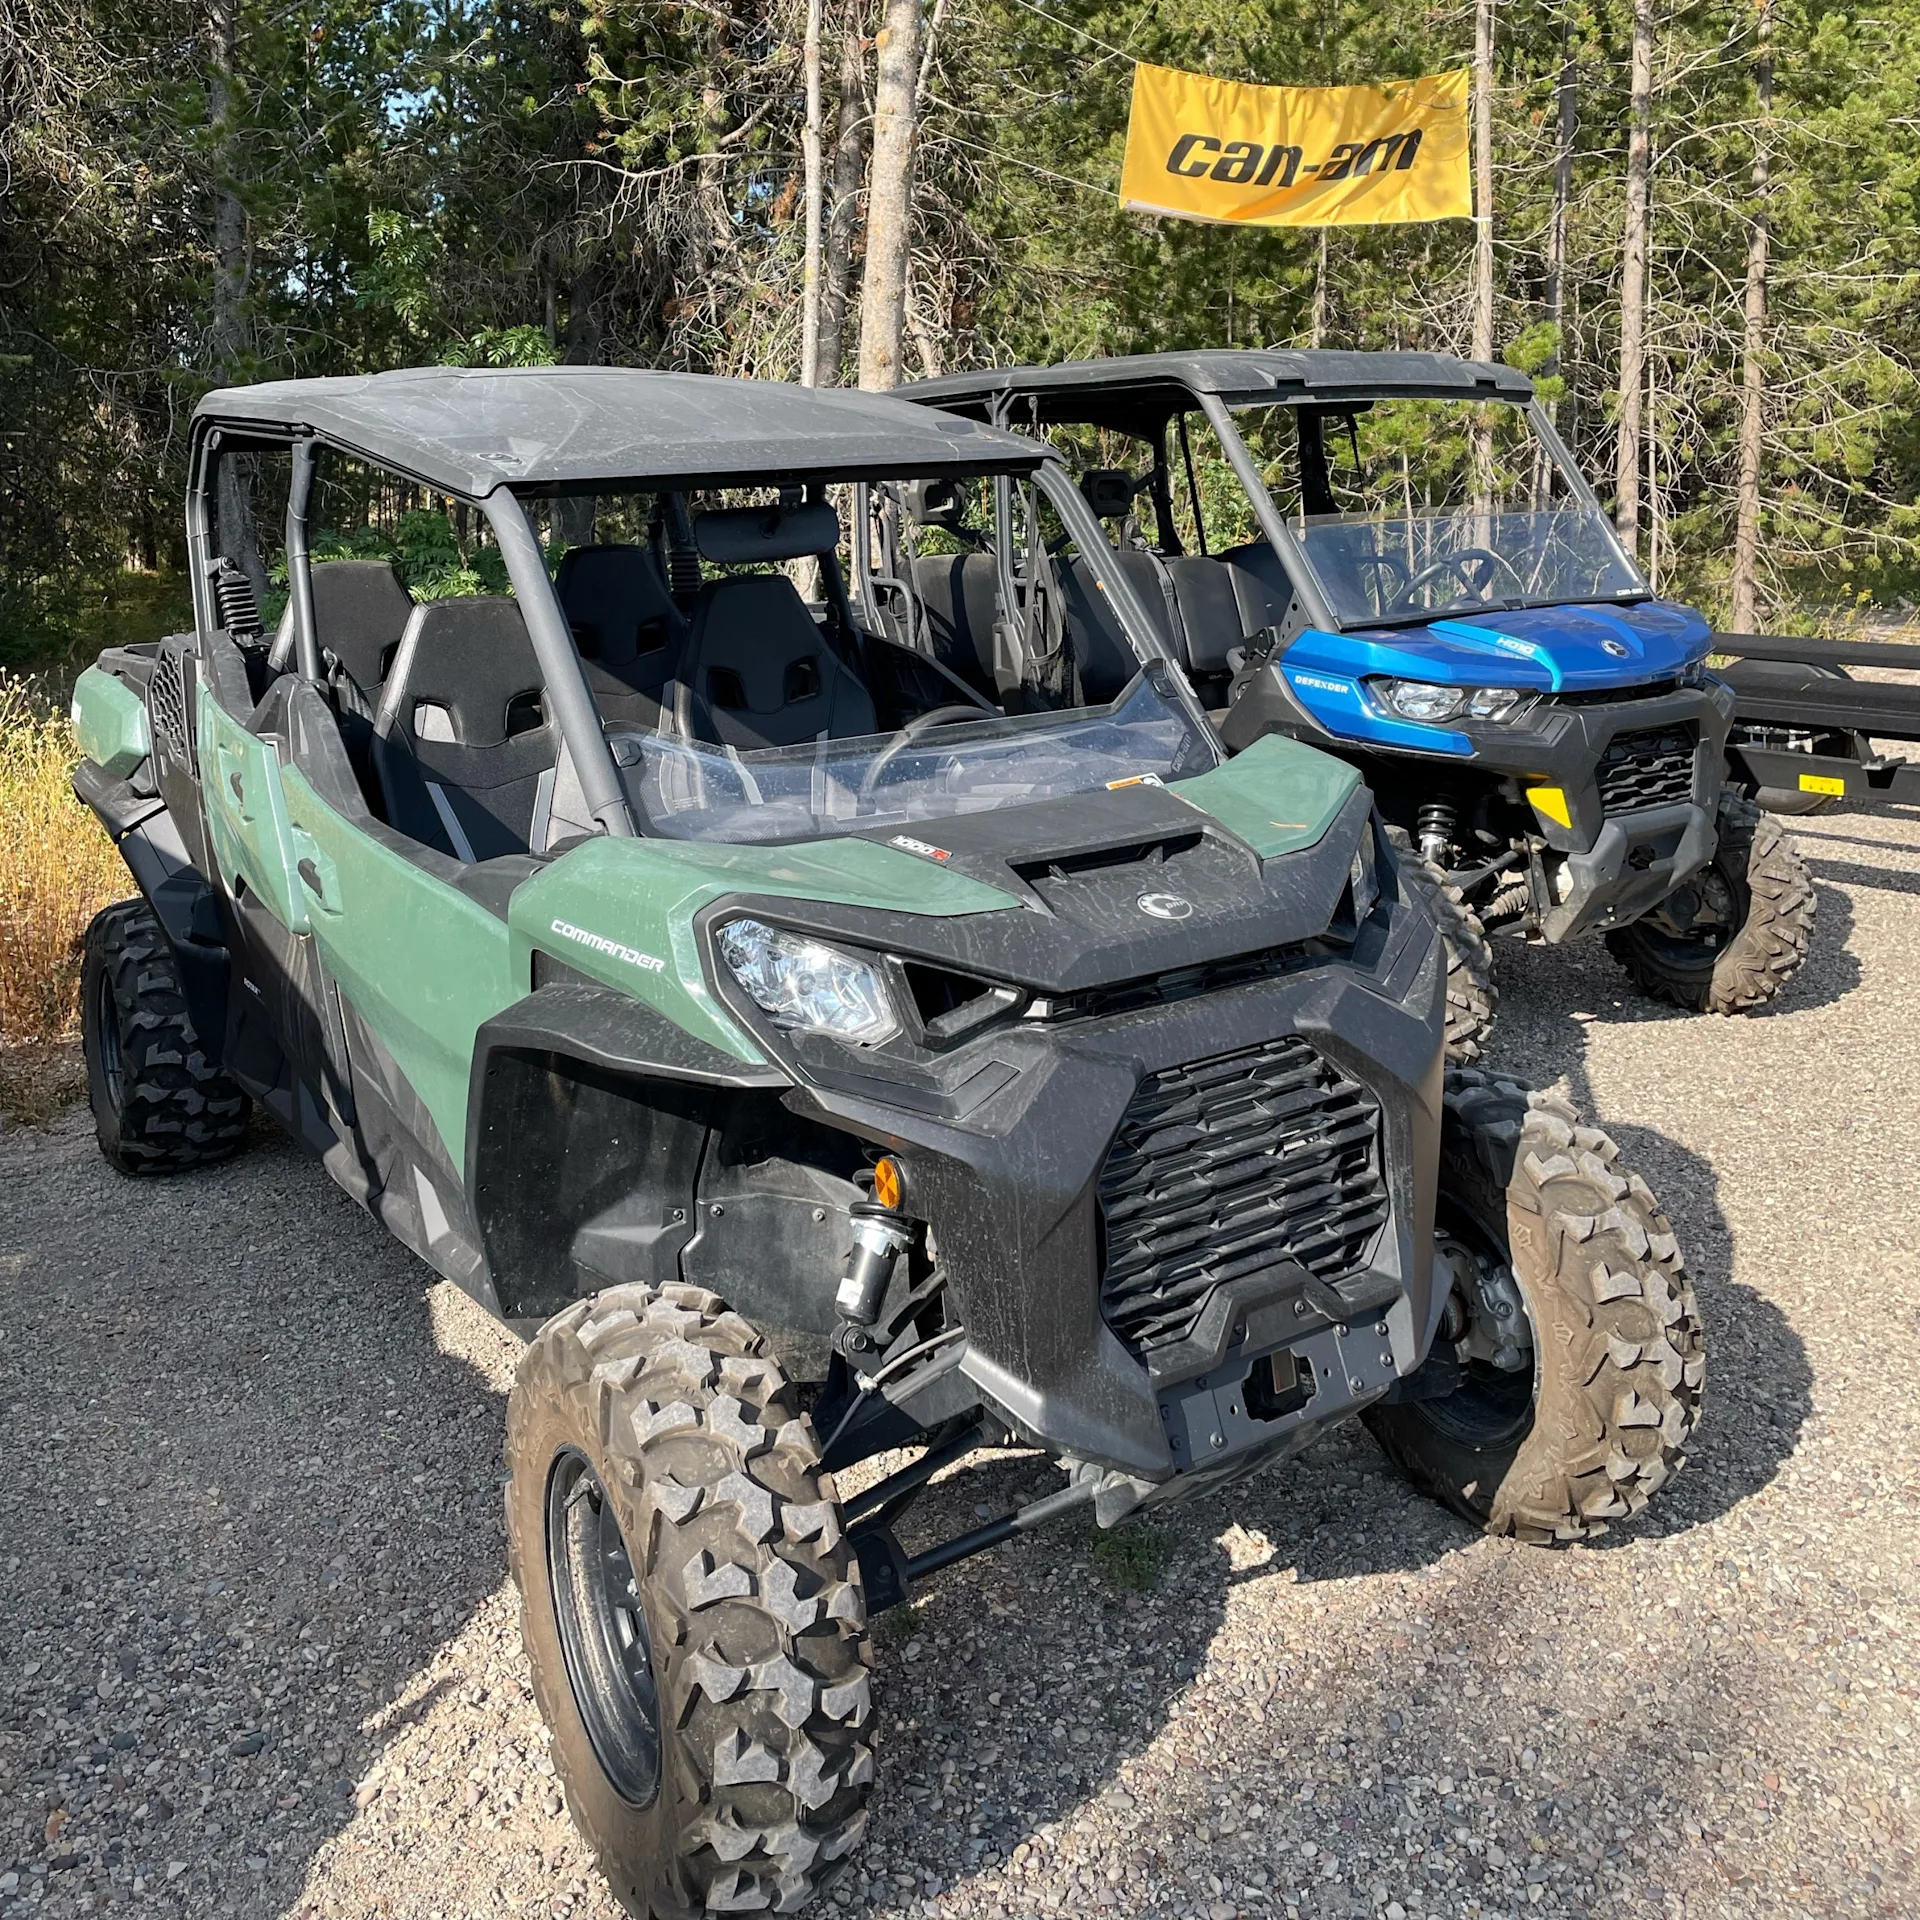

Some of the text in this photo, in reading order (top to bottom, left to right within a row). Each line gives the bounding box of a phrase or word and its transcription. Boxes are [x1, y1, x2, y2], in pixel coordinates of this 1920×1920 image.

[1166, 128, 1423, 187] can-am
[1496, 636, 1535, 655] HD10
[1294, 675, 1349, 694] DEFENDER
[890, 834, 951, 861] 1000R
[551, 919, 665, 973] COMMANDER
